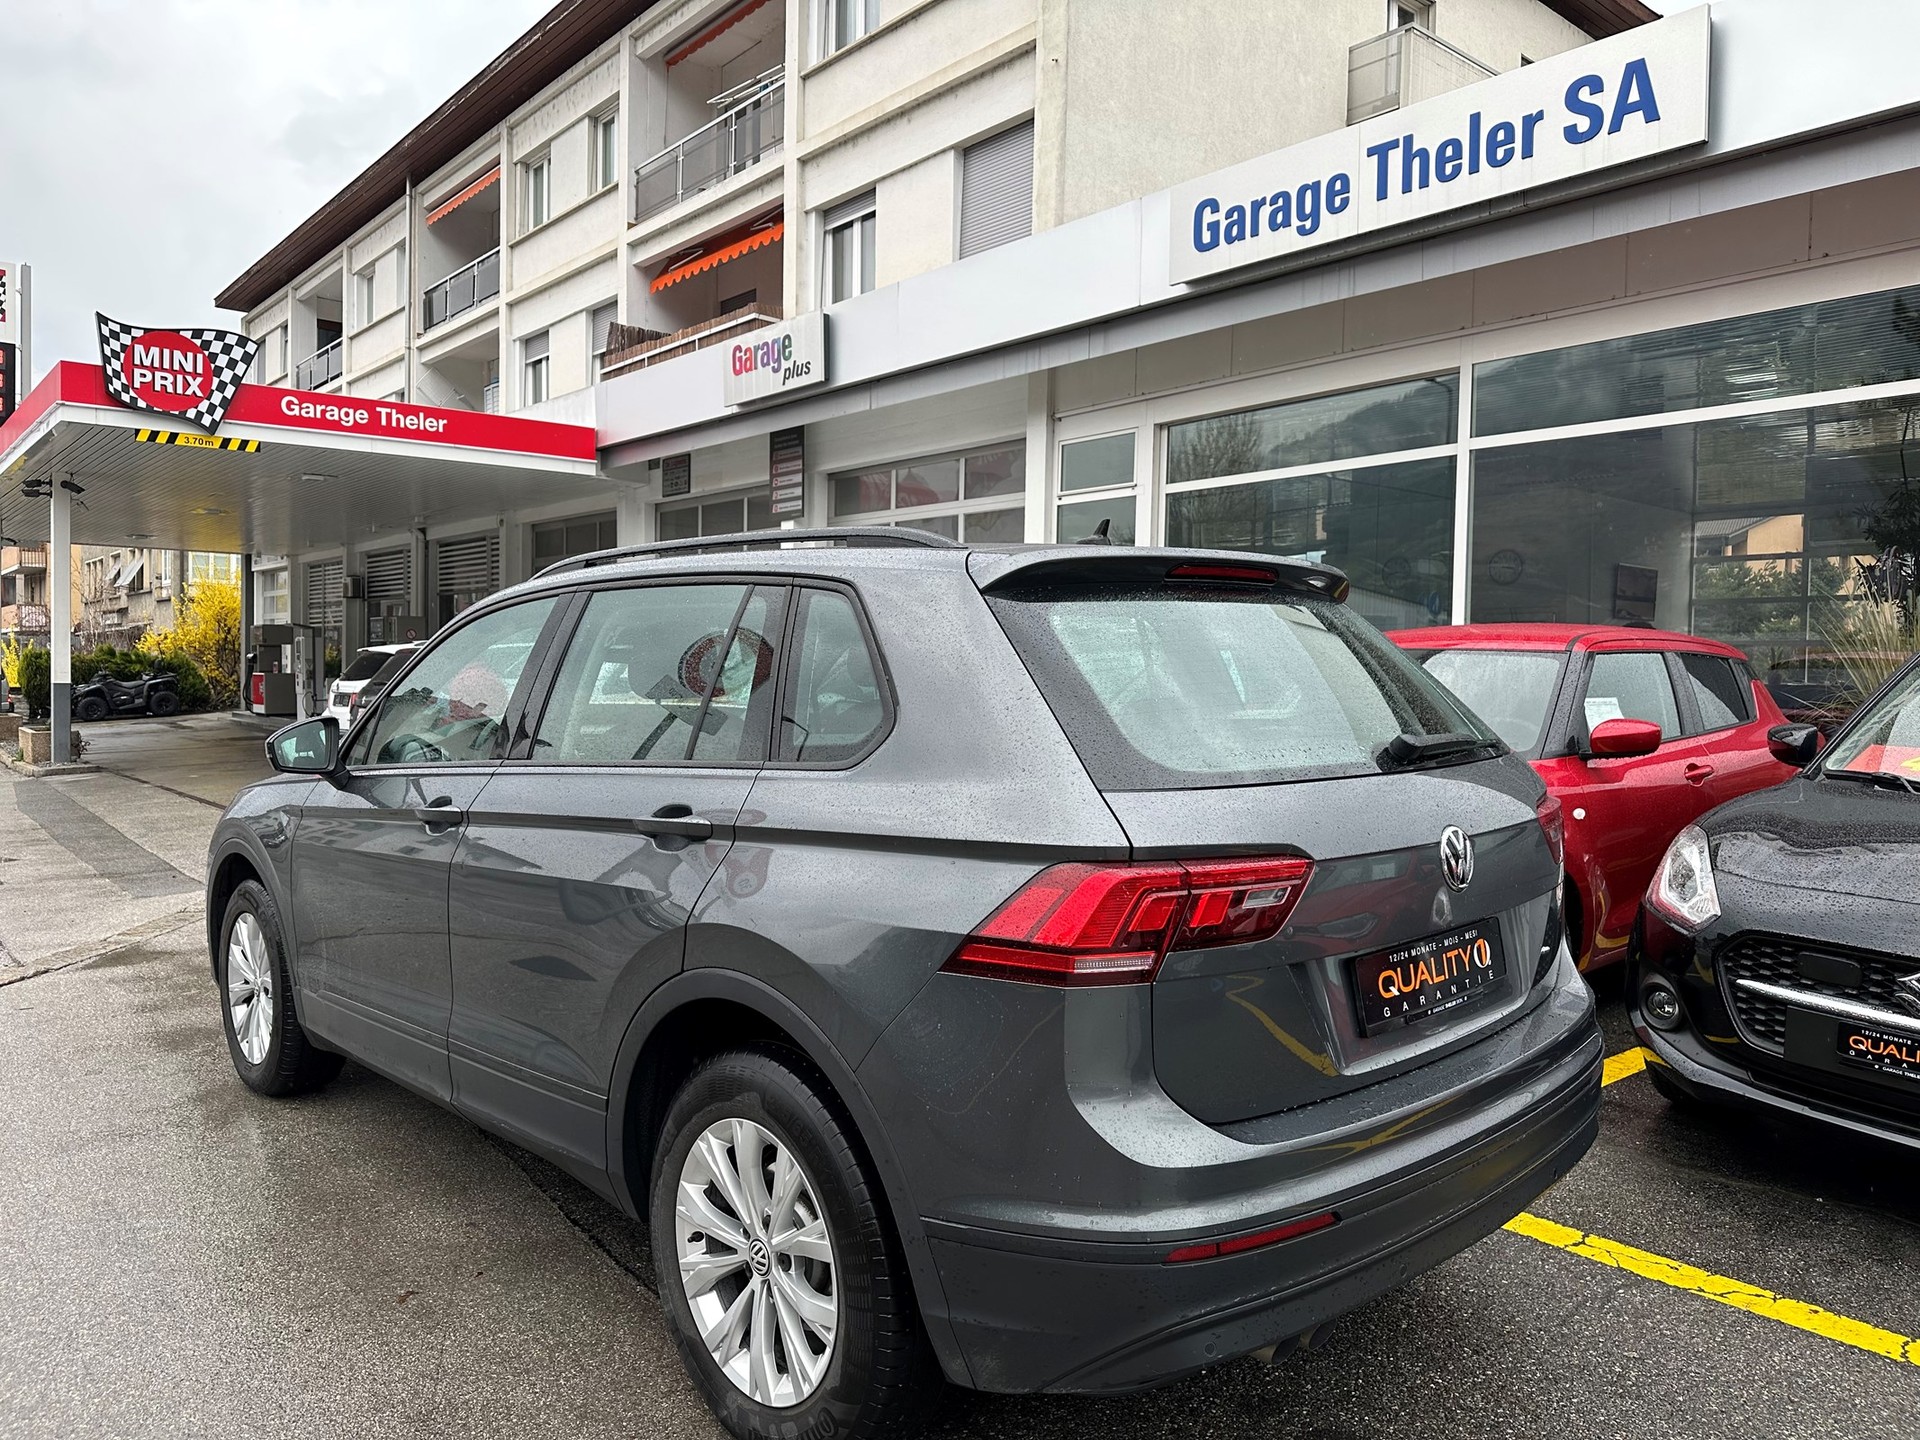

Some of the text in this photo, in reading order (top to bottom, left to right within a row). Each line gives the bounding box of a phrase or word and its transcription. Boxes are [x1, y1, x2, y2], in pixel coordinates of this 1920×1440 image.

[1192, 57, 1661, 253] Garage Theler SA
[133, 343, 204, 374] MINI
[732, 333, 793, 376] Garage
[133, 367, 204, 397] PRIX
[782, 360, 811, 386] plus
[280, 395, 448, 433] Garage Theler
[1389, 952, 1409, 963] 12/24
[1411, 942, 1437, 957] MONATE
[1443, 935, 1459, 947] MOIS
[1383, 969, 1494, 1018] GARANTIE
[1883, 1034, 1912, 1045] MONATE
